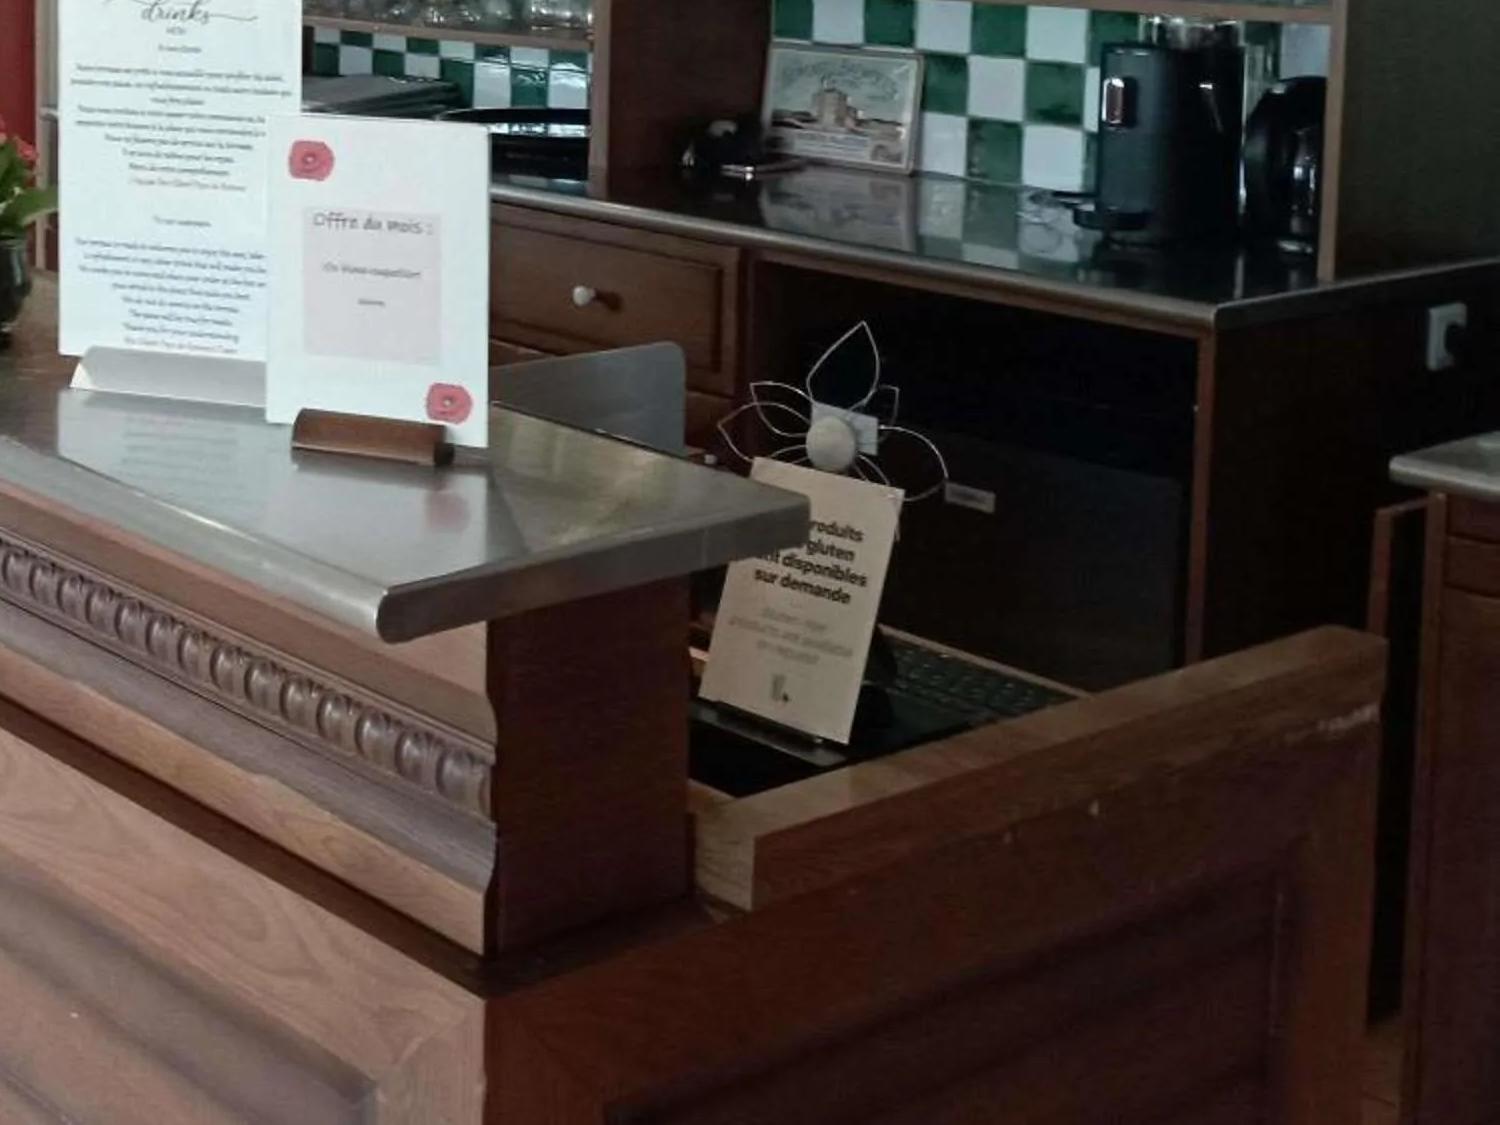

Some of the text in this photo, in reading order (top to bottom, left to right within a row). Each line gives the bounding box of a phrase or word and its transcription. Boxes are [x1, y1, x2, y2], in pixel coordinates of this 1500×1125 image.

[313, 210, 358, 231] Offre
[362, 212, 383, 230] du
[386, 218, 423, 235] mois
[810, 520, 865, 542] roduits
[805, 538, 855, 562] gluten
[781, 552, 868, 587] disponibles
[754, 568, 852, 604] sur demande
